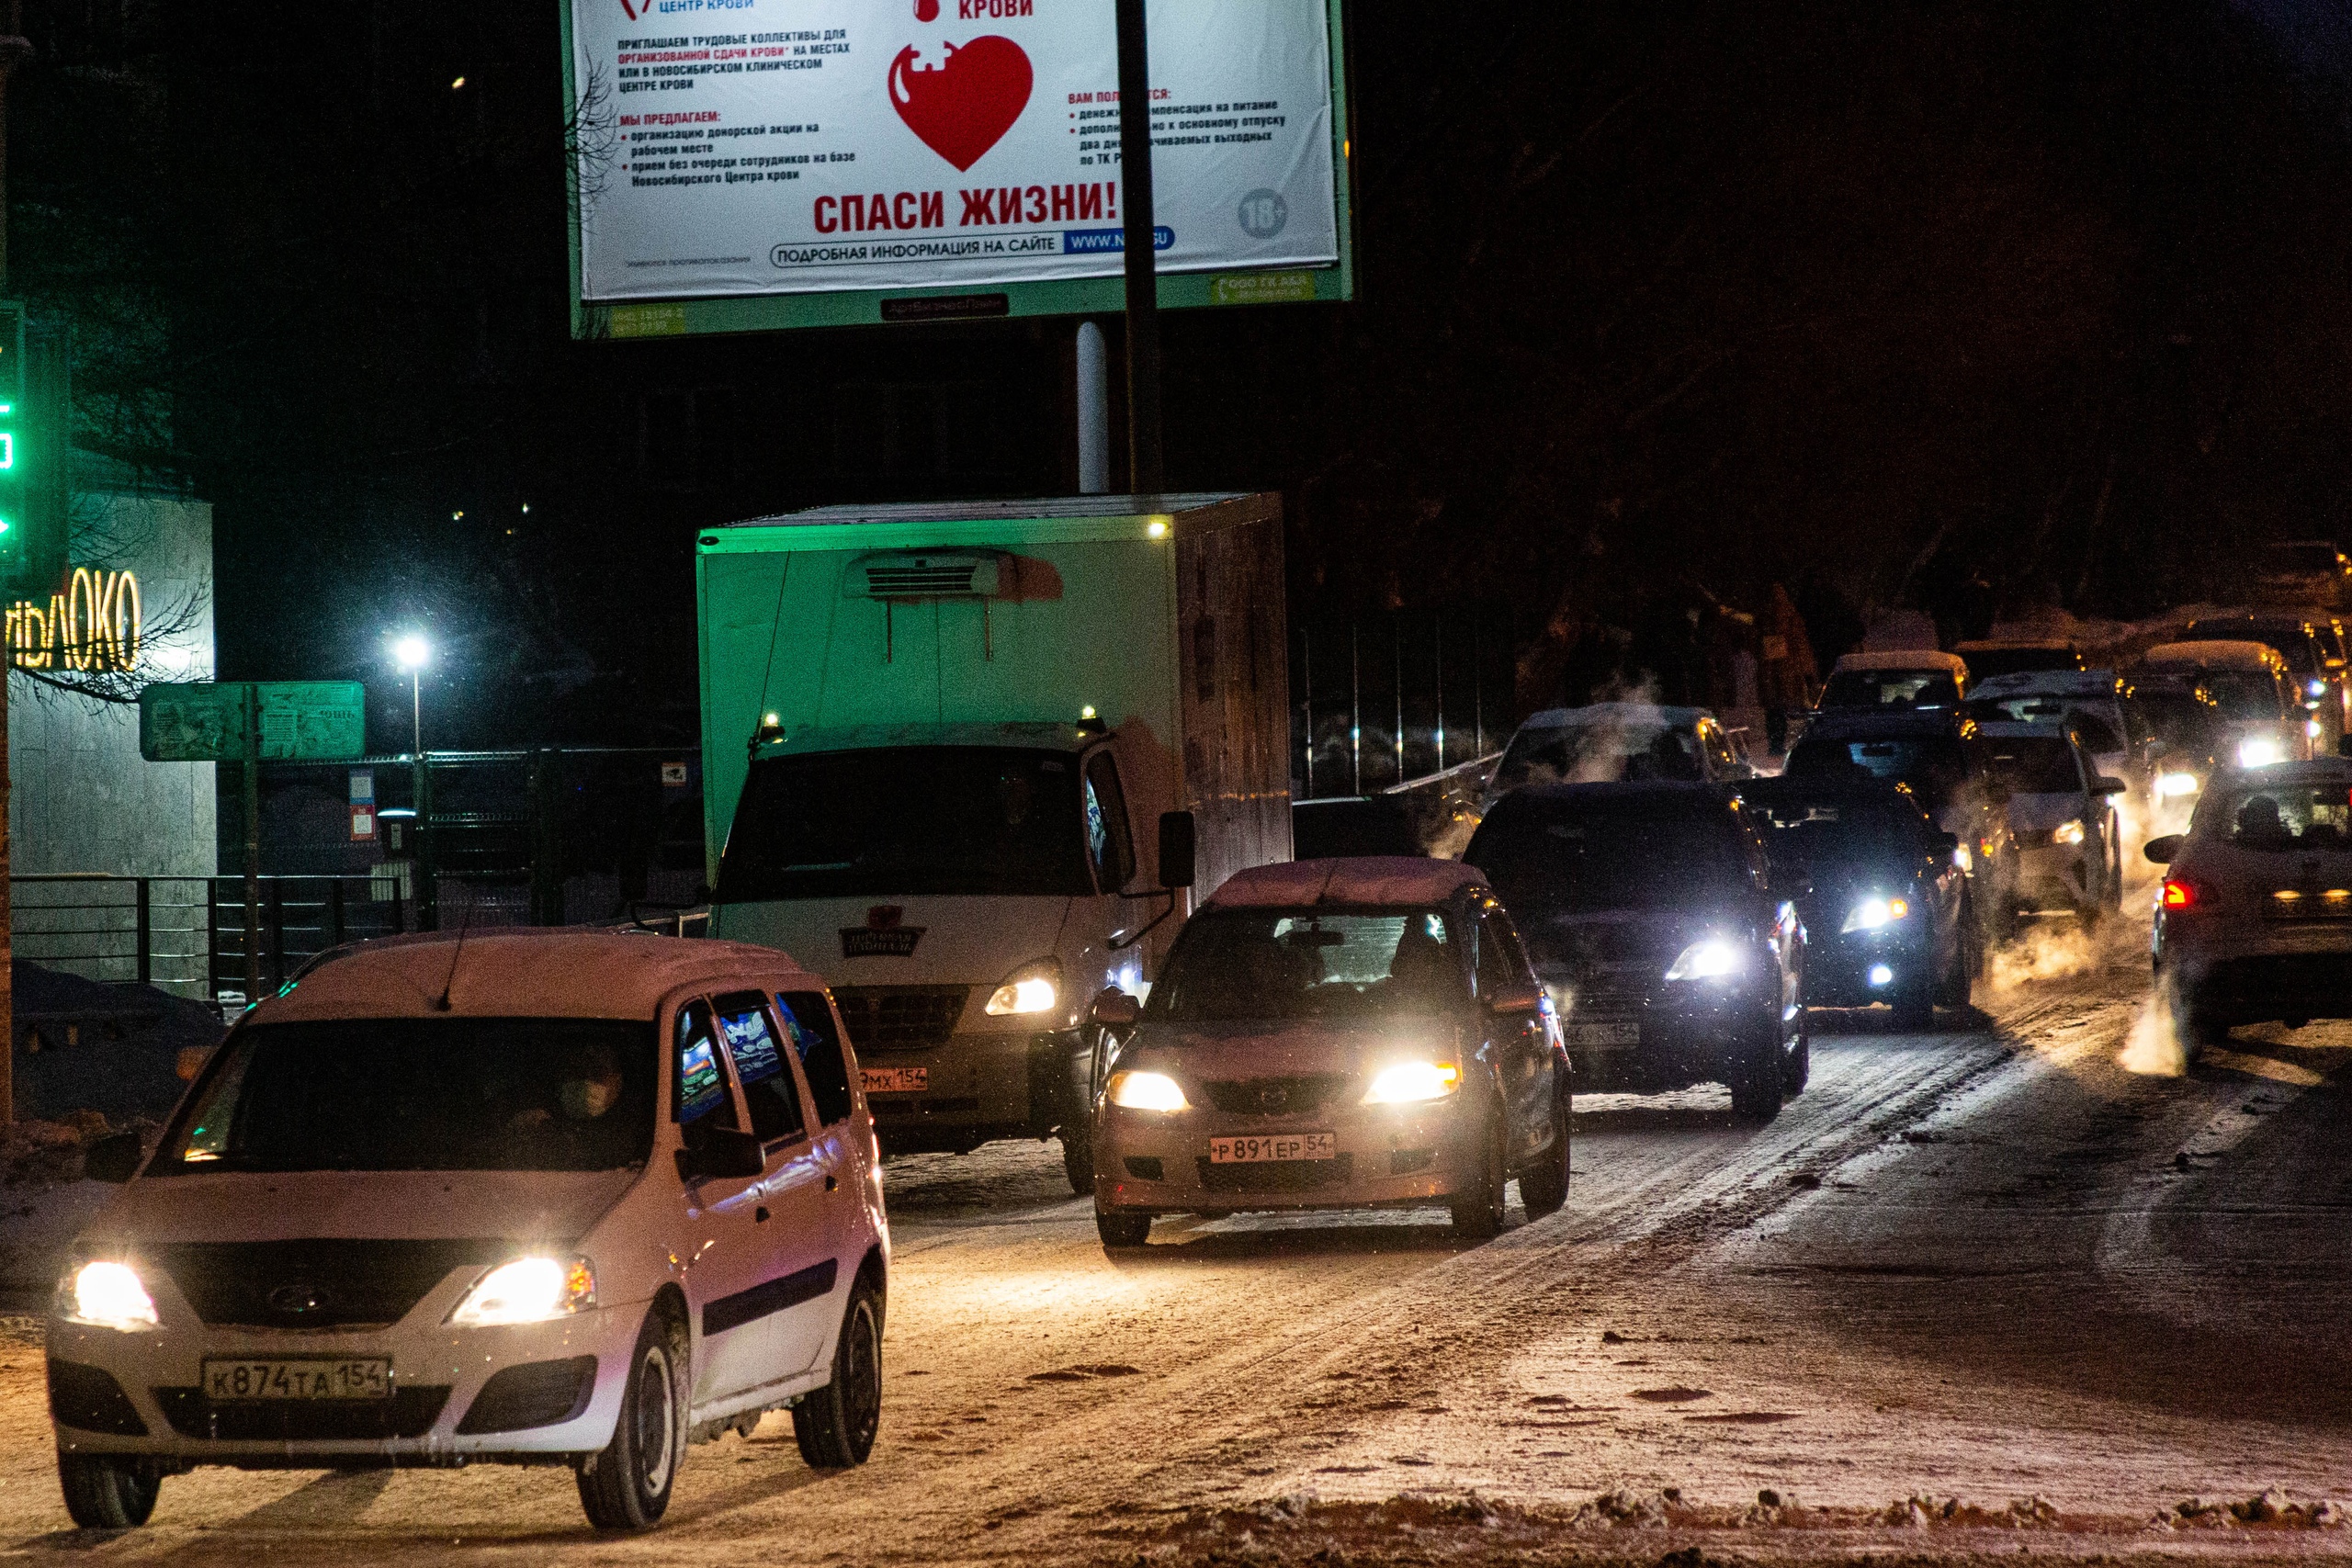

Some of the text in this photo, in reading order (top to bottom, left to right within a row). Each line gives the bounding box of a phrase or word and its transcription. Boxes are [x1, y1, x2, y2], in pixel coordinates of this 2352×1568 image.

[660, 0, 753, 13] ЦЕНТР КРОВИ
[959, 0, 1033, 18] КРОВИ
[617, 28, 846, 51] ПРИГЛАШАЕМ ТРУДОВЫЕ КОЛЛЕКТИВЫ ДЛЯ
[618, 50, 710, 64] ОРГАНИЗОВАННОЙ
[713, 49, 748, 61] СДАЧИ
[794, 45, 807, 55] НА
[810, 43, 850, 54] МЕСТАХ
[618, 59, 822, 78] ИЛИ В НОВОСИБИРСКОМ КЛИНИЧЕСКОМ
[619, 80, 694, 93] ЦЕНТРЕ КРОВИ
[1069, 93, 1092, 104] ВАМ
[1216, 104, 1228, 112] на
[1233, 101, 1278, 111] питание
[620, 111, 721, 126] МЫ ПРЕДЛАГАЕМ:
[1179, 118, 1238, 129] основному
[1242, 117, 1285, 128] отпуску
[631, 122, 819, 141] организацию донорской акции на
[631, 143, 713, 158] рабочем месте
[1080, 141, 1100, 151] два
[1215, 132, 1272, 143] выходных
[632, 151, 855, 174] прием без очереди сотрудников на базе
[1080, 157, 1093, 165] по
[1097, 153, 1110, 164] ТК
[632, 170, 799, 187] Новосибирского Центра крови
[814, 181, 1116, 234] СПАСИ ЖИЗНИ!
[1243, 197, 1284, 229] 18+
[777, 246, 866, 264] ПОДРОБНАЯ
[871, 242, 980, 262] ИНФОРМАЦИЯ
[985, 241, 1005, 254] НА
[1008, 236, 1055, 252] САЙТЕ
